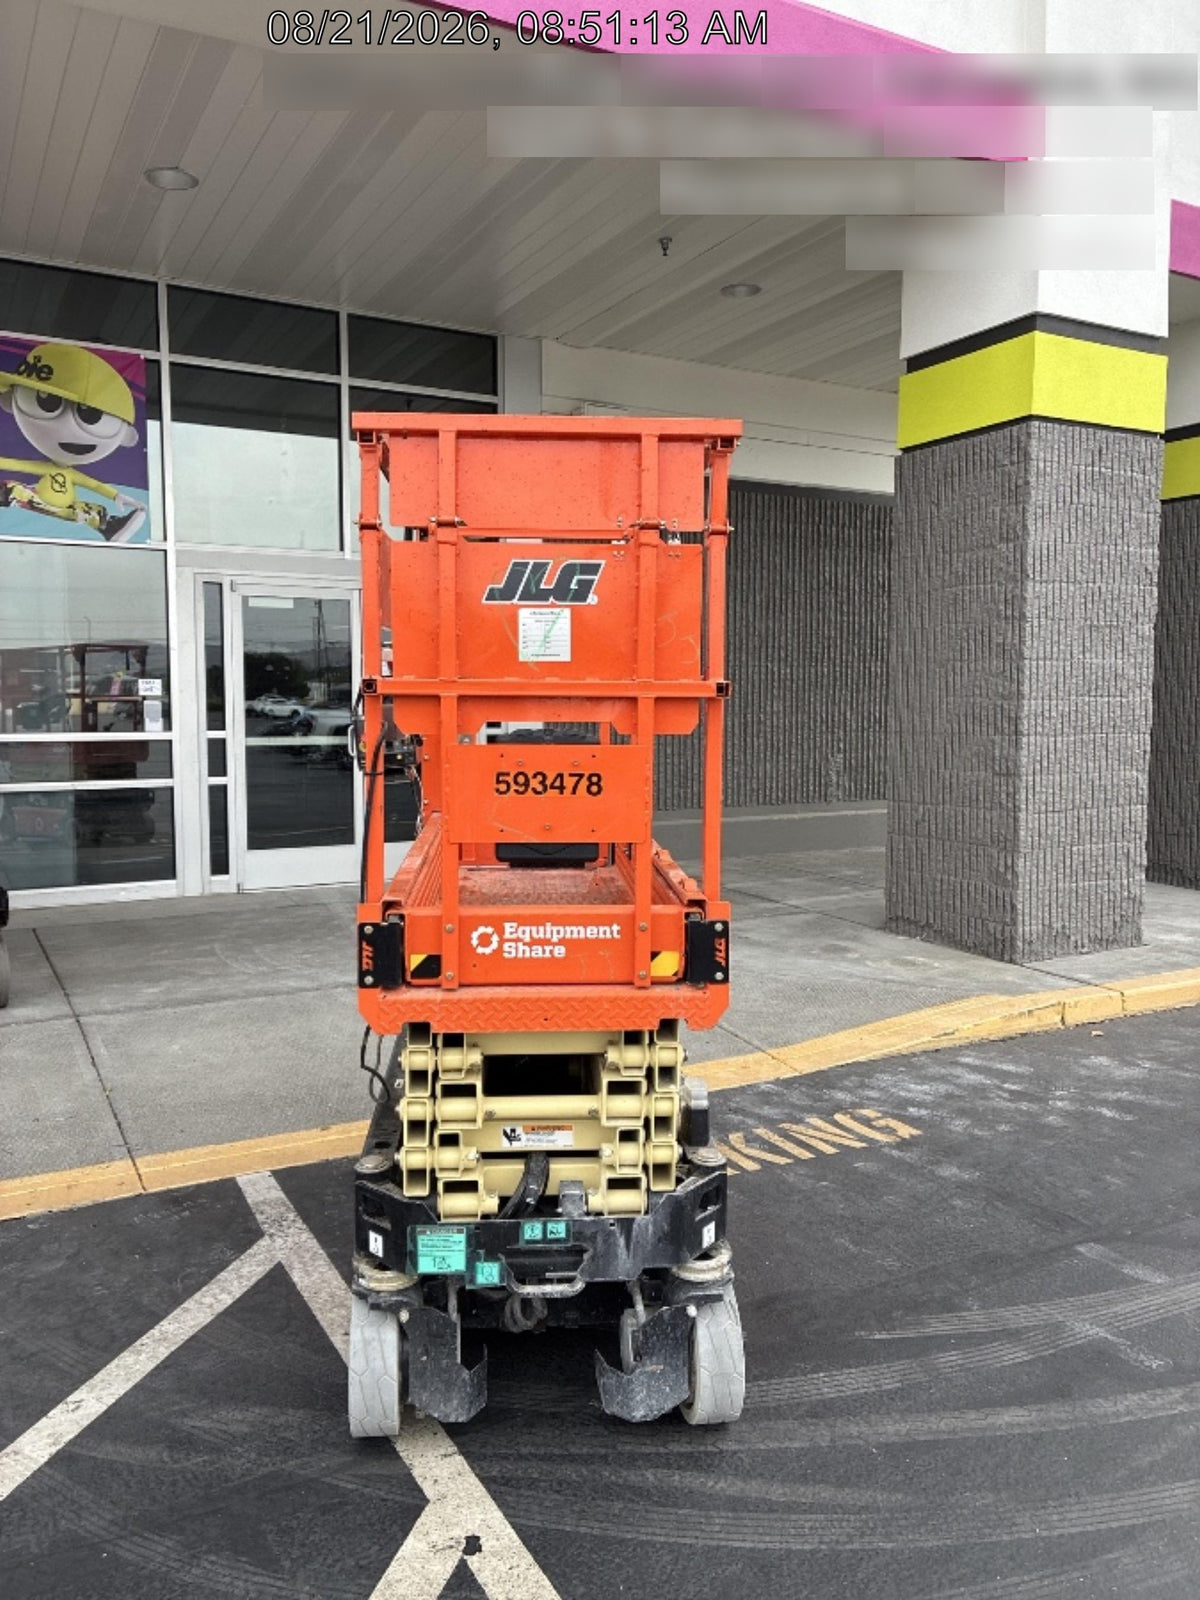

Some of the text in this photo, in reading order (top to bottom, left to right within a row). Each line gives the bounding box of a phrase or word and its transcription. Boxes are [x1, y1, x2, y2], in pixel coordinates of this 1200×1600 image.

[482, 560, 605, 605] JLG
[494, 771, 604, 797] 593478
[503, 921, 621, 942] Equipment
[503, 942, 566, 959] Share
